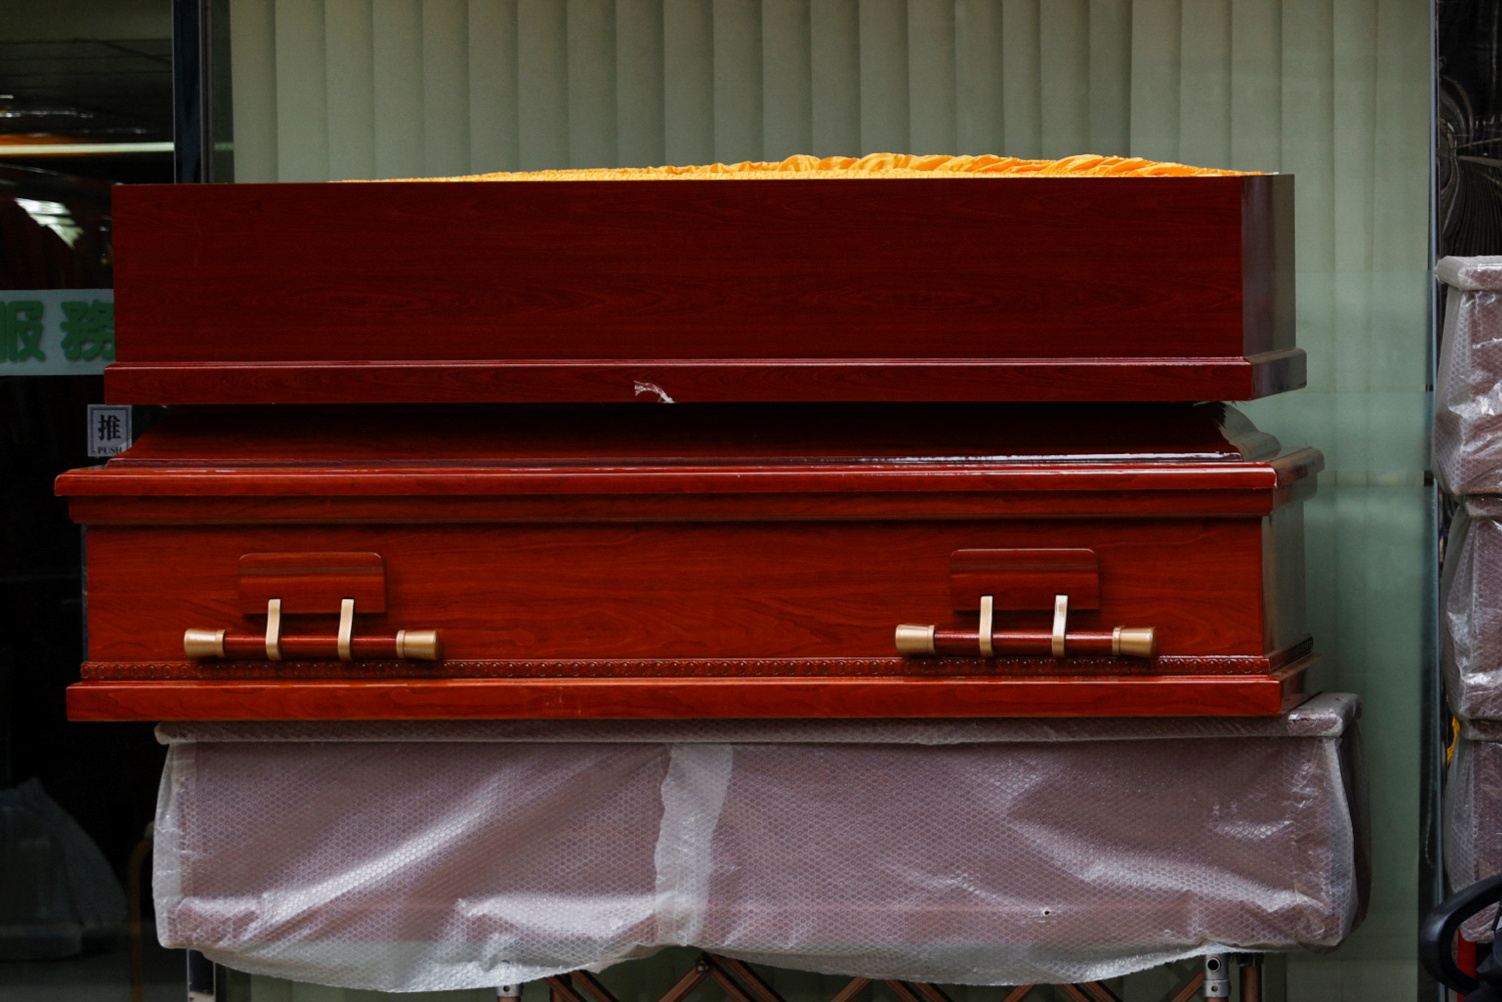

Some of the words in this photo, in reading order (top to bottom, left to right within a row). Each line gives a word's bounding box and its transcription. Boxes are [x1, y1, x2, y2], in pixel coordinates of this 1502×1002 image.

[0, 299, 115, 362] 服務
[98, 414, 121, 441] 推
[97, 446, 122, 455] PUSH
